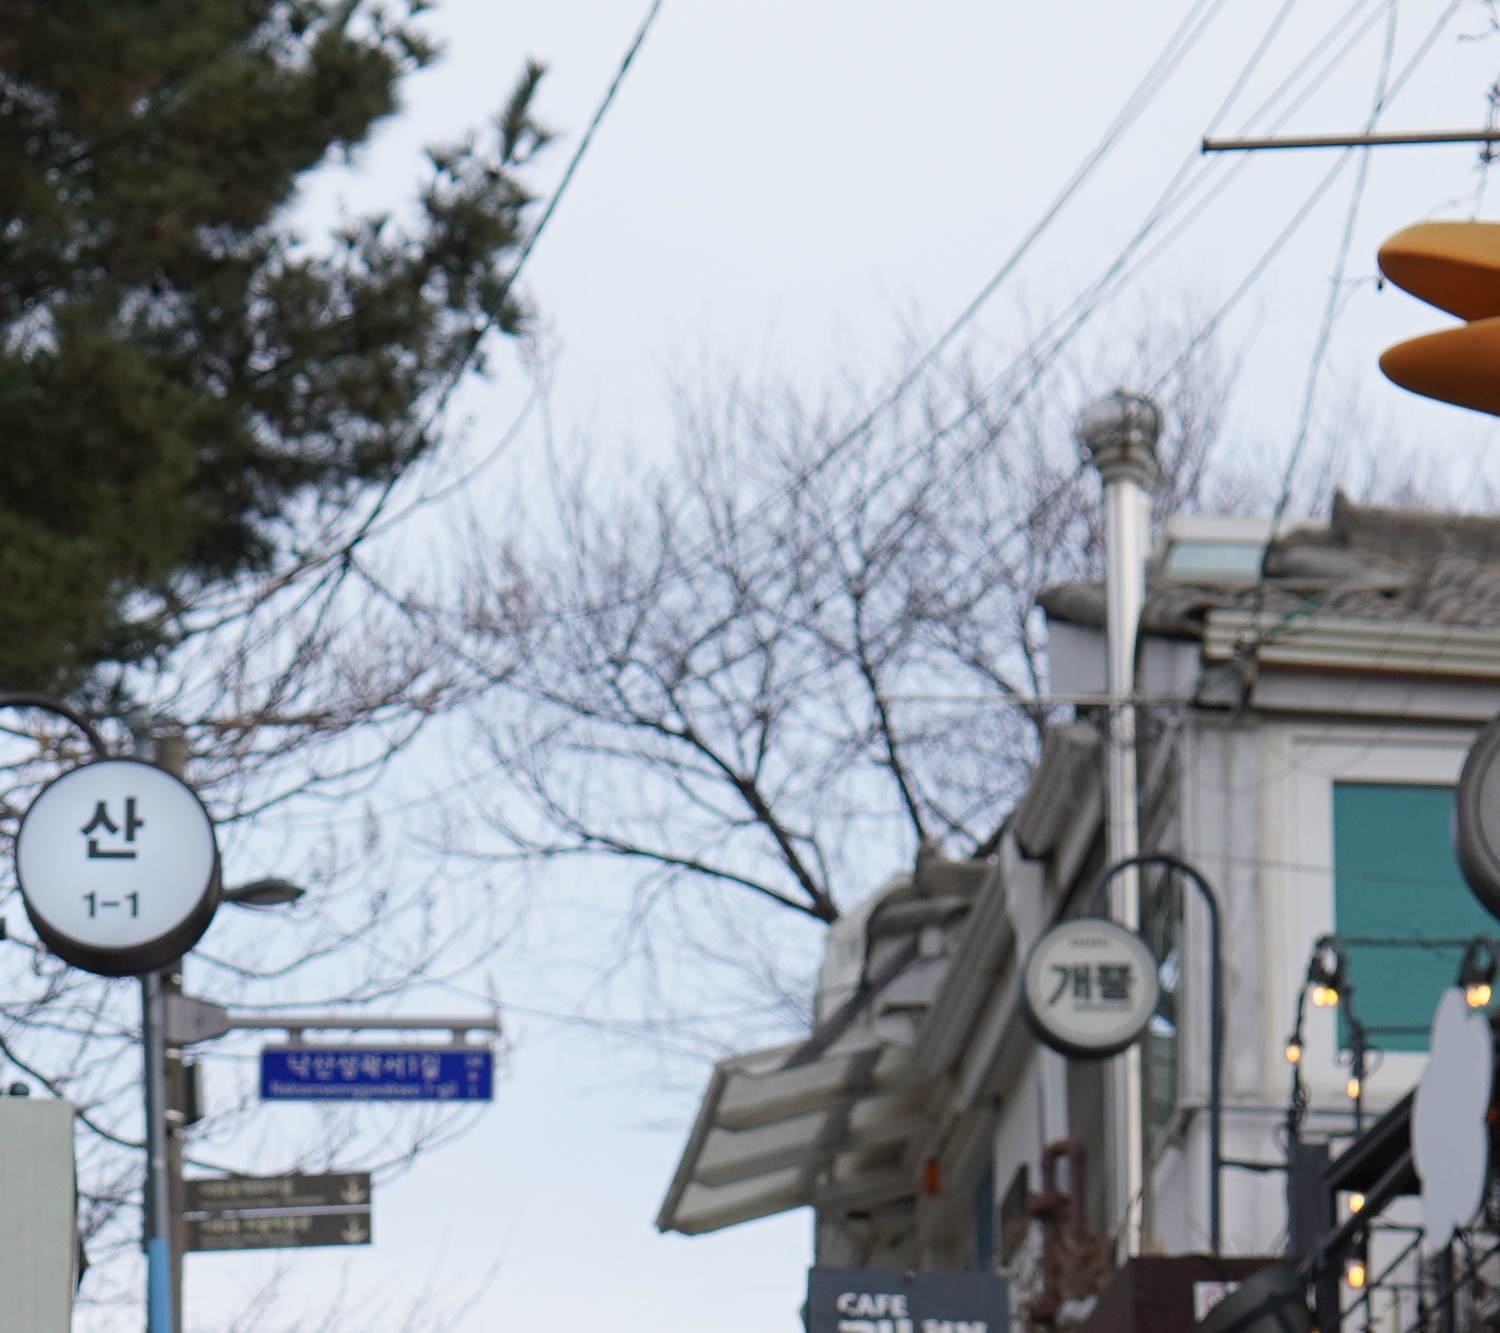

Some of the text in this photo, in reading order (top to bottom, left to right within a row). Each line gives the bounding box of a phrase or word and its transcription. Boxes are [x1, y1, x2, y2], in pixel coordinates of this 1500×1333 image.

[81, 795, 144, 861] 산
[83, 890, 141, 919] 1-1
[837, 1292, 909, 1319] CAFE
